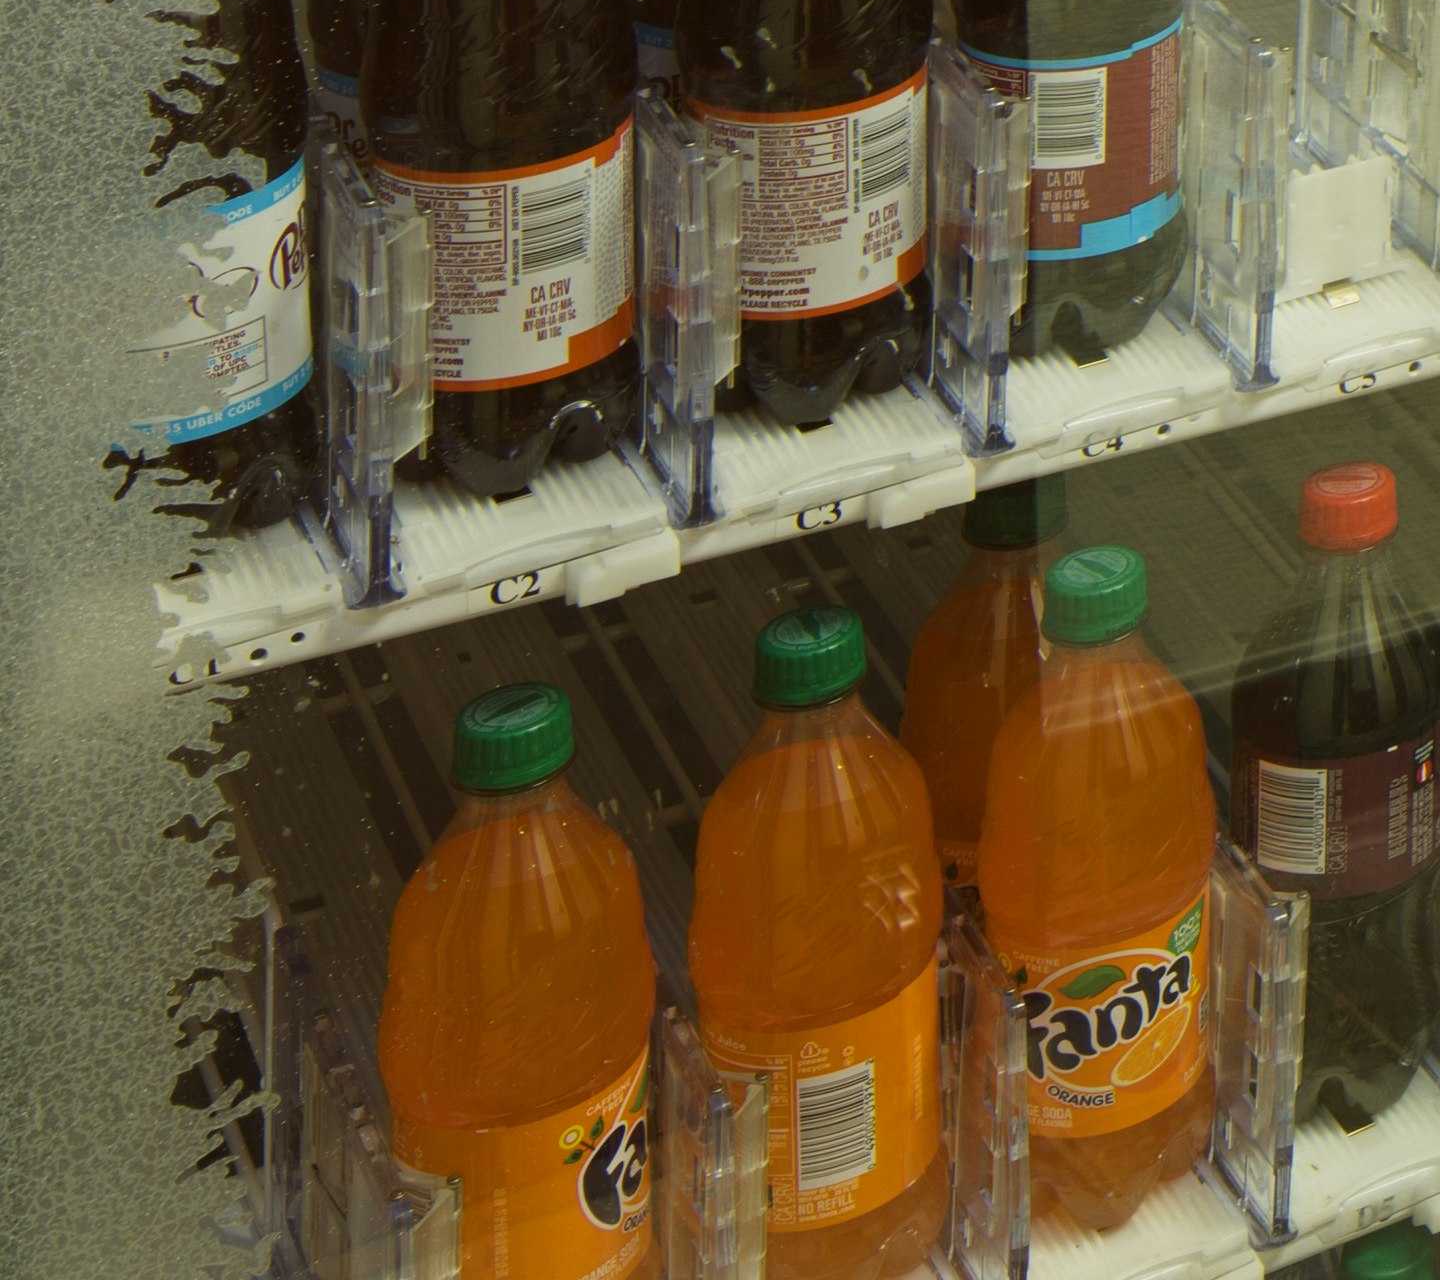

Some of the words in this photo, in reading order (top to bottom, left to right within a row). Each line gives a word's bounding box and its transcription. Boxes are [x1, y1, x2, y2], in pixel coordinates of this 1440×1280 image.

[1047, 171, 1061, 188] CA
[1064, 169, 1085, 187] CRV
[868, 209, 880, 228] CA
[883, 200, 899, 222] CRV
[531, 285, 546, 304] CA
[550, 278, 571, 299] CRV
[741, 299, 769, 308] PLEASE
[771, 299, 808, 308] RECYCLE
[187, 409, 223, 431] UBER
[228, 396, 262, 419] CODE
[795, 500, 842, 531] C3
[489, 570, 541, 606] C2
[1013, 951, 1060, 967] CAFFEINE
[1026, 963, 1049, 974] FREE
[1022, 955, 1191, 1080] Fanta
[797, 1056, 828, 1067] please
[798, 1063, 831, 1073] recycle
[586, 1077, 632, 1117] CAFFEINE
[602, 1096, 624, 1116] FREE
[1048, 1085, 1114, 1107] ORANGE
[1043, 1107, 1072, 1119] SODA
[774, 1179, 793, 1203] CRV
[775, 1204, 793, 1223] CA
[798, 1201, 814, 1214] NO
[817, 1194, 853, 1213] REFILL
